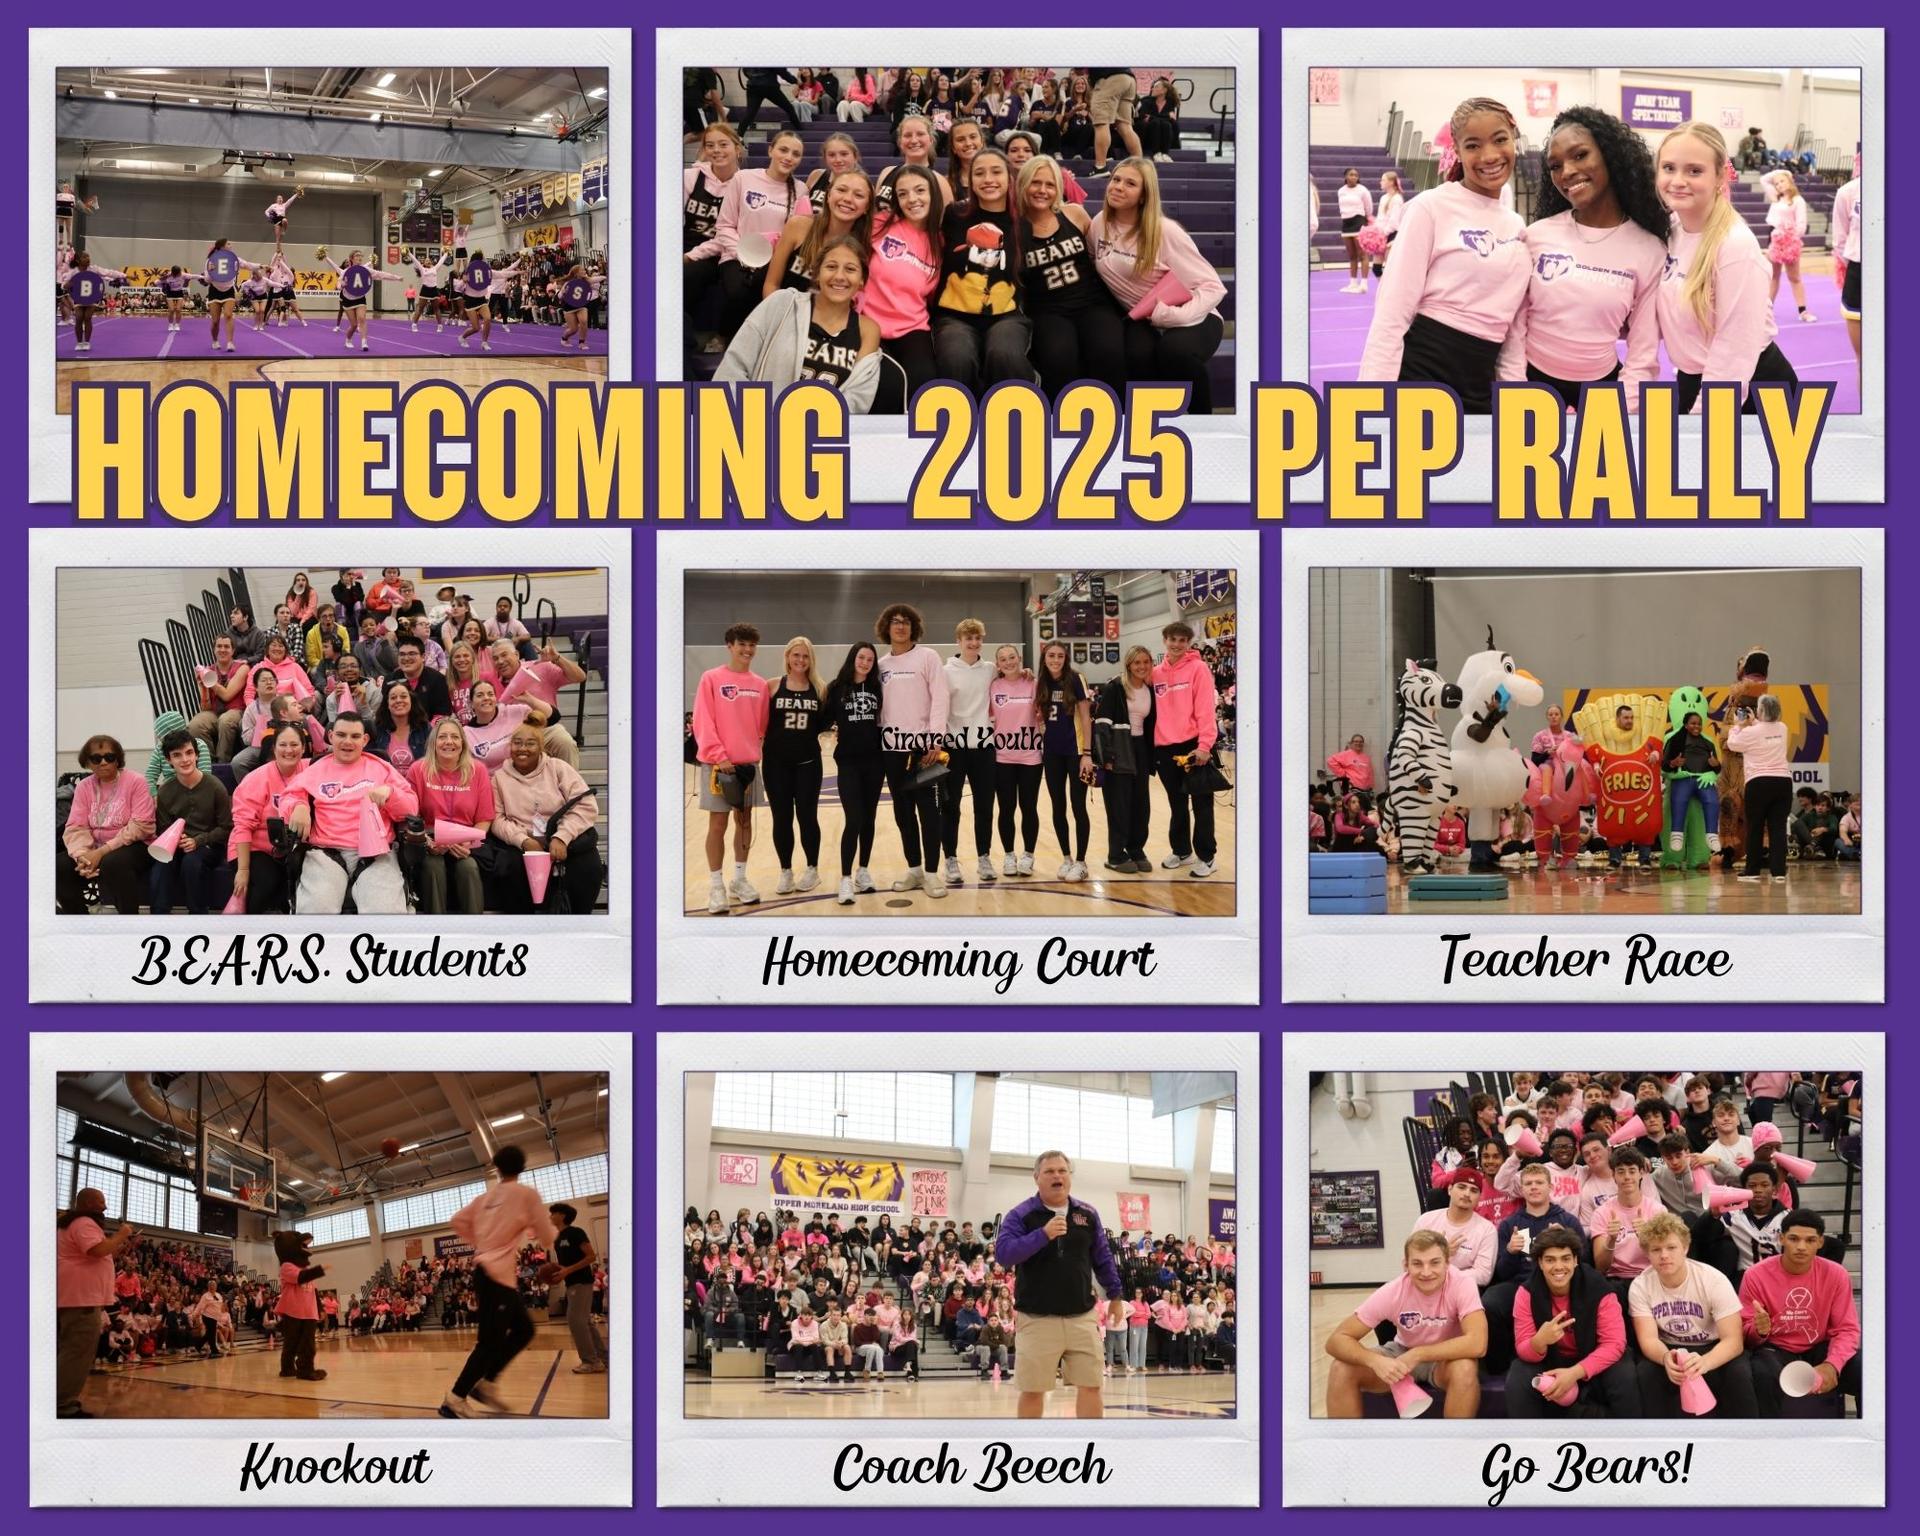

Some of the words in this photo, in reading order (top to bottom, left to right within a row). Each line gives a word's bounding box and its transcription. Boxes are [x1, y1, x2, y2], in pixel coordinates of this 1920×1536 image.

[1635, 94, 1656, 108] AWAY
[1658, 95, 1680, 110] TEAM
[1632, 108, 1682, 123] SPECTATORS
[687, 199, 719, 218] BEA
[1025, 236, 1085, 268] BEARS
[217, 258, 228, 275] E
[1575, 263, 1610, 274] GOLDEN
[353, 272, 363, 289] A
[474, 268, 484, 284] R
[1043, 260, 1080, 290] 28
[80, 280, 93, 298] B
[573, 285, 583, 300] S
[805, 340, 858, 369] EARS
[775, 697, 818, 711] BEARS
[784, 712, 809, 730] 28
[1603, 770, 1651, 794] FRIES
[1791, 770, 1823, 783] OOL
[774, 1198, 802, 1208] UPPER
[803, 1201, 849, 1211] MORELAND
[850, 1203, 869, 1212] HIGH
[870, 1205, 900, 1214] SCHOOL
[914, 1195, 946, 1210] PINK
[1222, 1207, 1236, 1220] AWA
[1219, 1222, 1236, 1234] SPE
[1652, 1302, 1670, 1319] PPER
